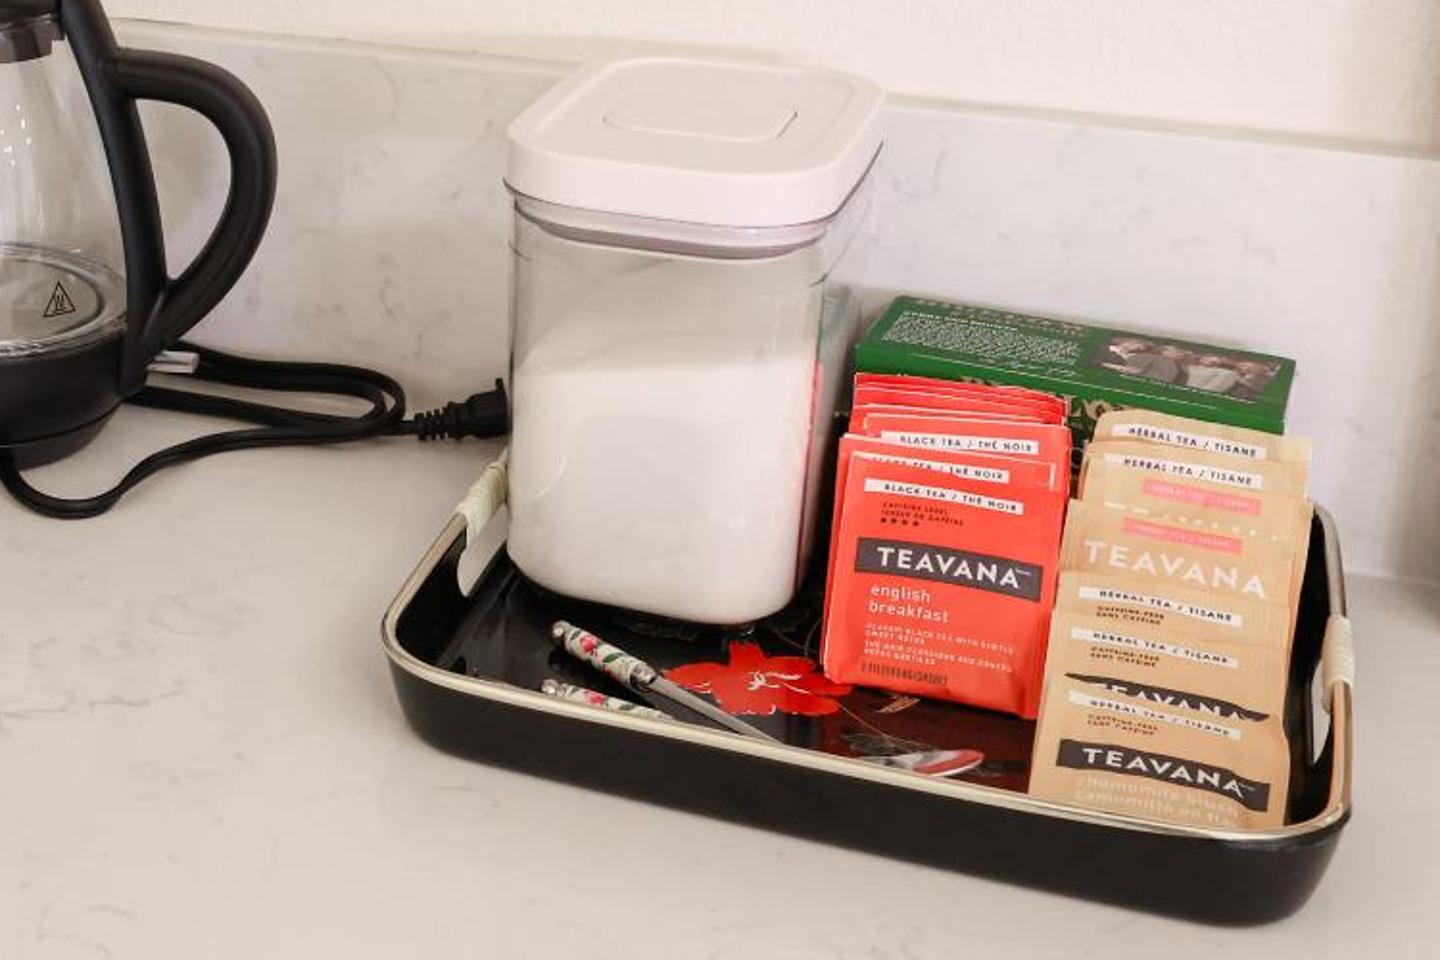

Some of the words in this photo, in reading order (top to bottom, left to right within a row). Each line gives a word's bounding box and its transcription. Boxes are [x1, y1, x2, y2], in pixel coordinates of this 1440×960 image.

[900, 435, 936, 445] BLACK
[942, 438, 961, 447] TEA
[1003, 443, 1032, 452] NOIR
[1129, 427, 1171, 442] HERBAL
[1176, 435, 1197, 446] TEA
[1214, 443, 1257, 457] TISANE
[974, 469, 1003, 480] NOIR
[1124, 458, 1166, 472] HERBAL
[1172, 465, 1193, 476] TEA
[1211, 471, 1253, 485] TISANE
[884, 483, 920, 494] BLACK
[926, 486, 946, 497] TEA
[988, 501, 1017, 512] NOIR
[877, 546, 1019, 589] TEAVANA
[1084, 540, 1266, 599] TEAVANA
[871, 585, 930, 602] english
[868, 600, 948, 623] breakfast
[1150, 596, 1172, 609] TEA
[1189, 607, 1232, 622] TISANE
[1145, 640, 1166, 651] TEA
[1185, 649, 1228, 664] TISANE
[1082, 748, 1245, 799] TEAVANA
